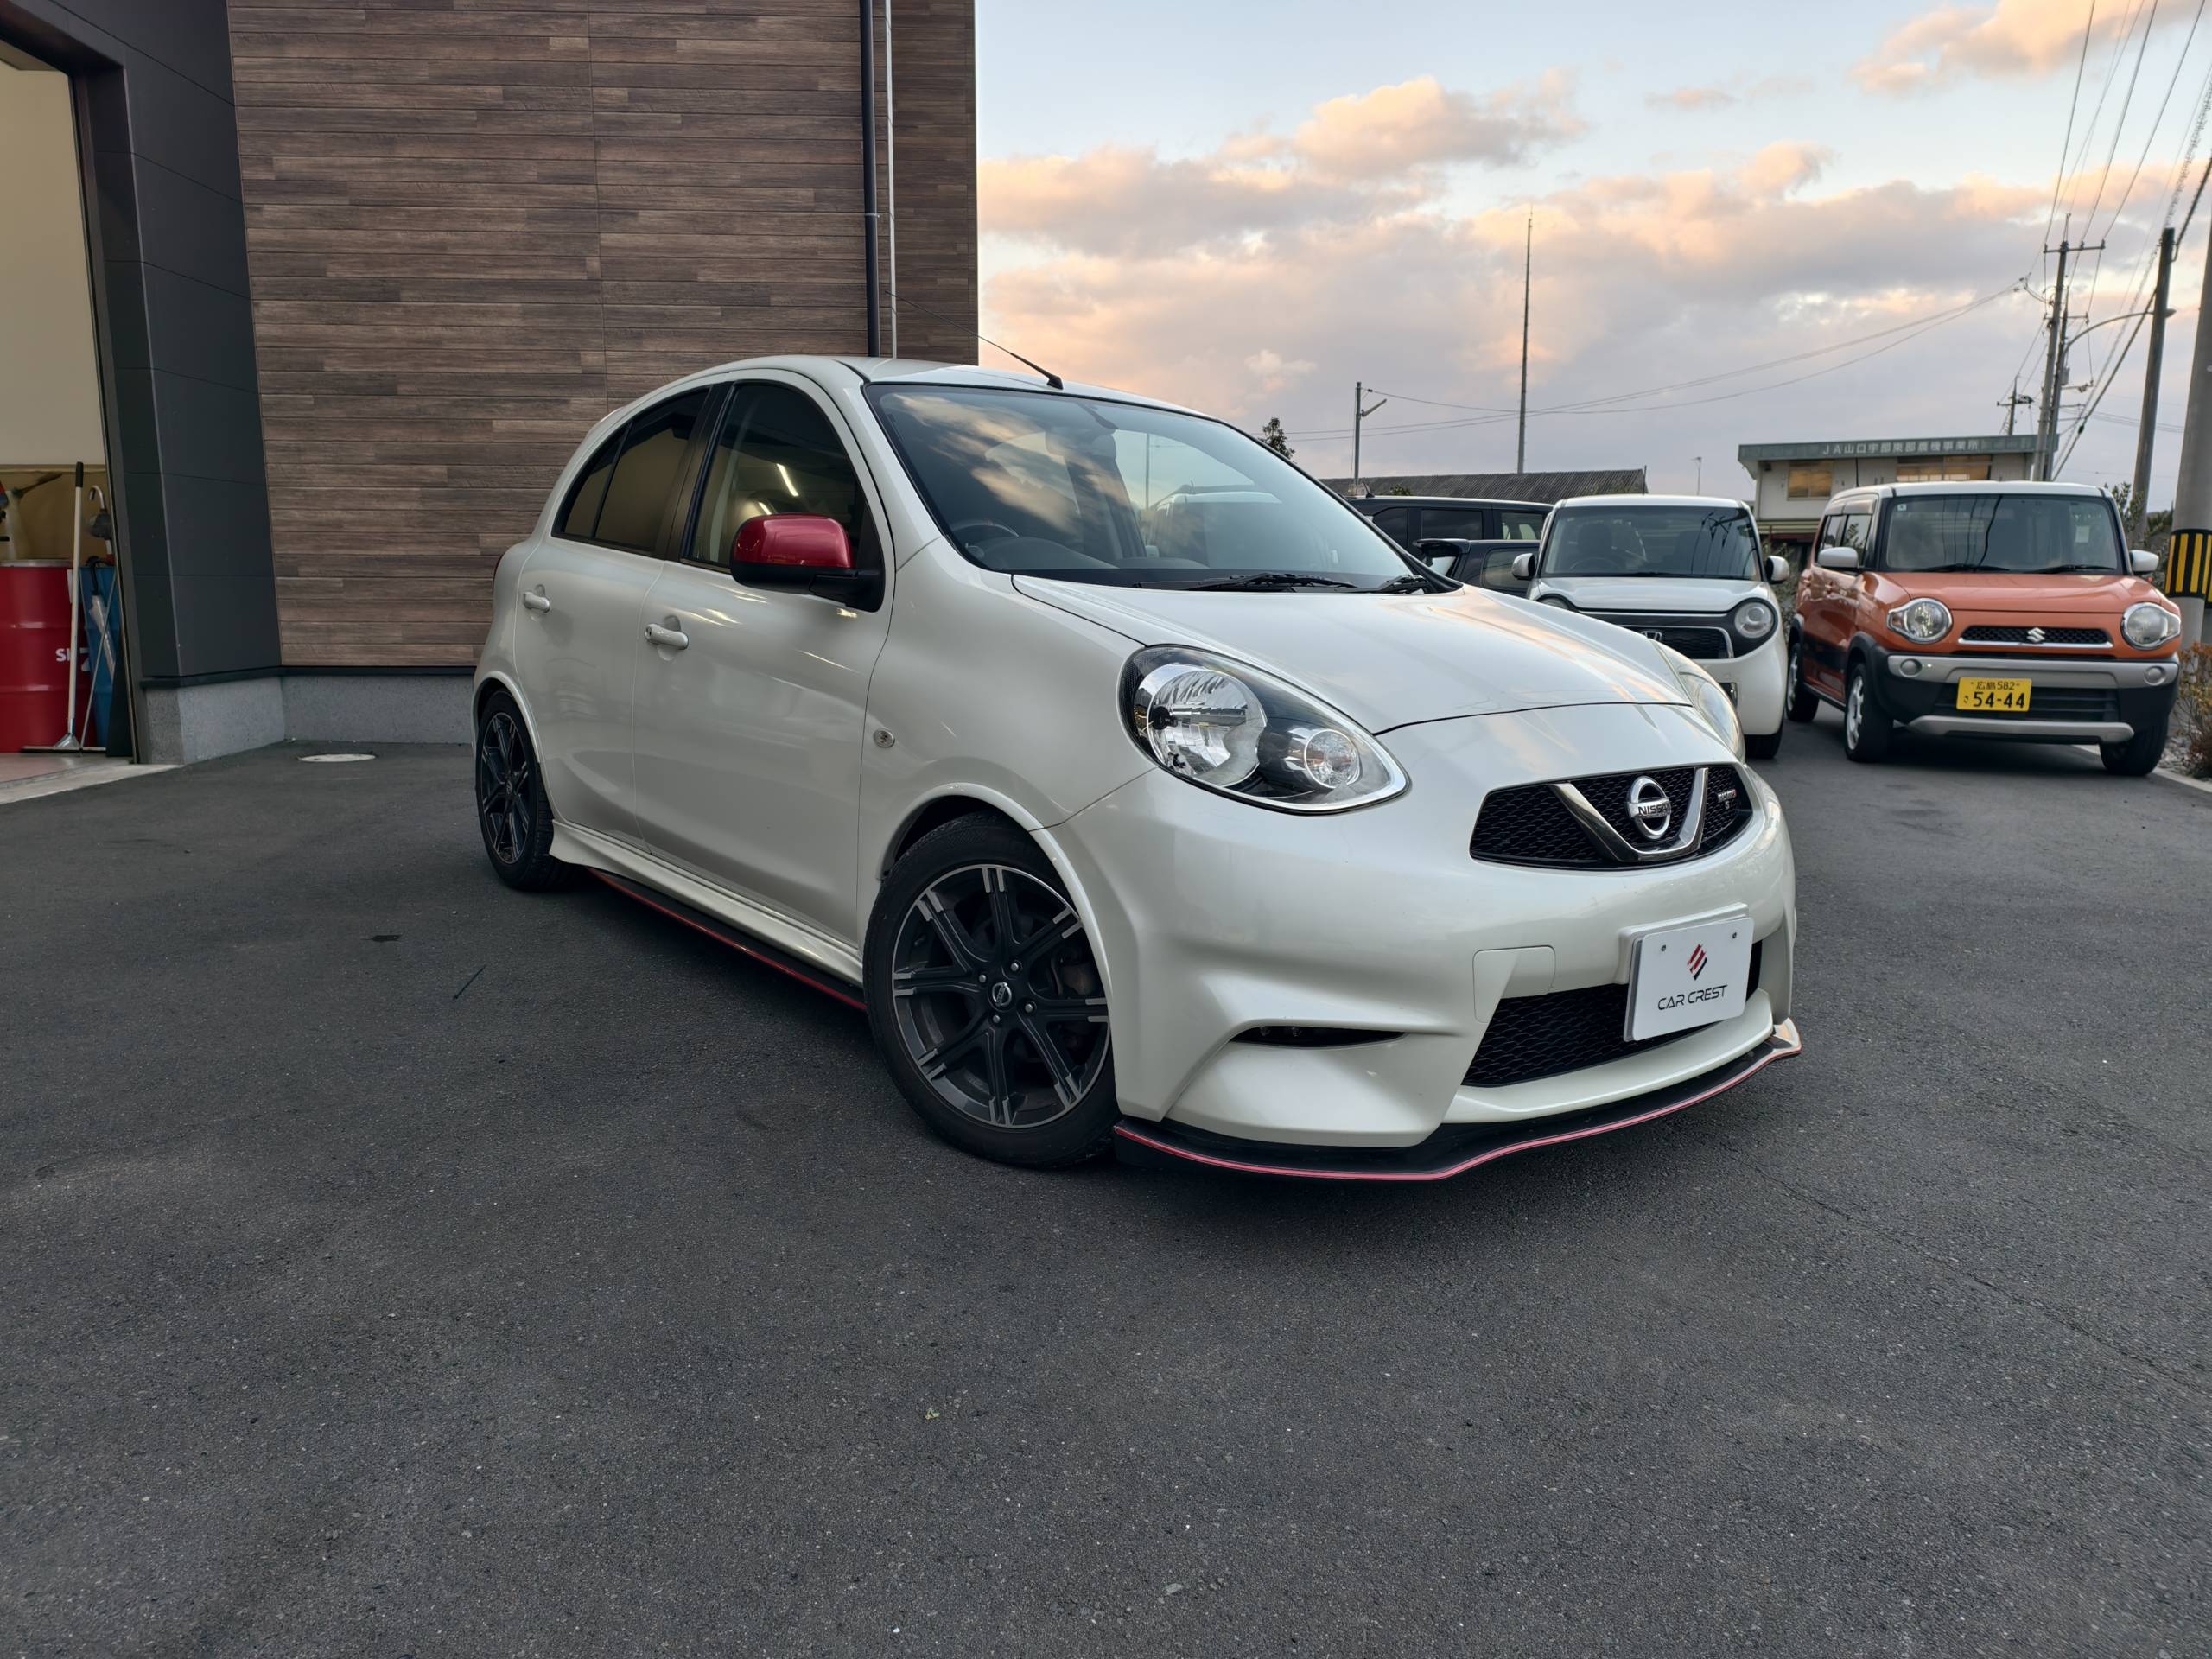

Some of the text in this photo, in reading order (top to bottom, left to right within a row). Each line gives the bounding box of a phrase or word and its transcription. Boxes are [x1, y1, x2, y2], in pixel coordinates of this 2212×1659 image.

[1974, 692, 2024, 708] 54-44
[1657, 984, 1728, 1010] CAR CREST
